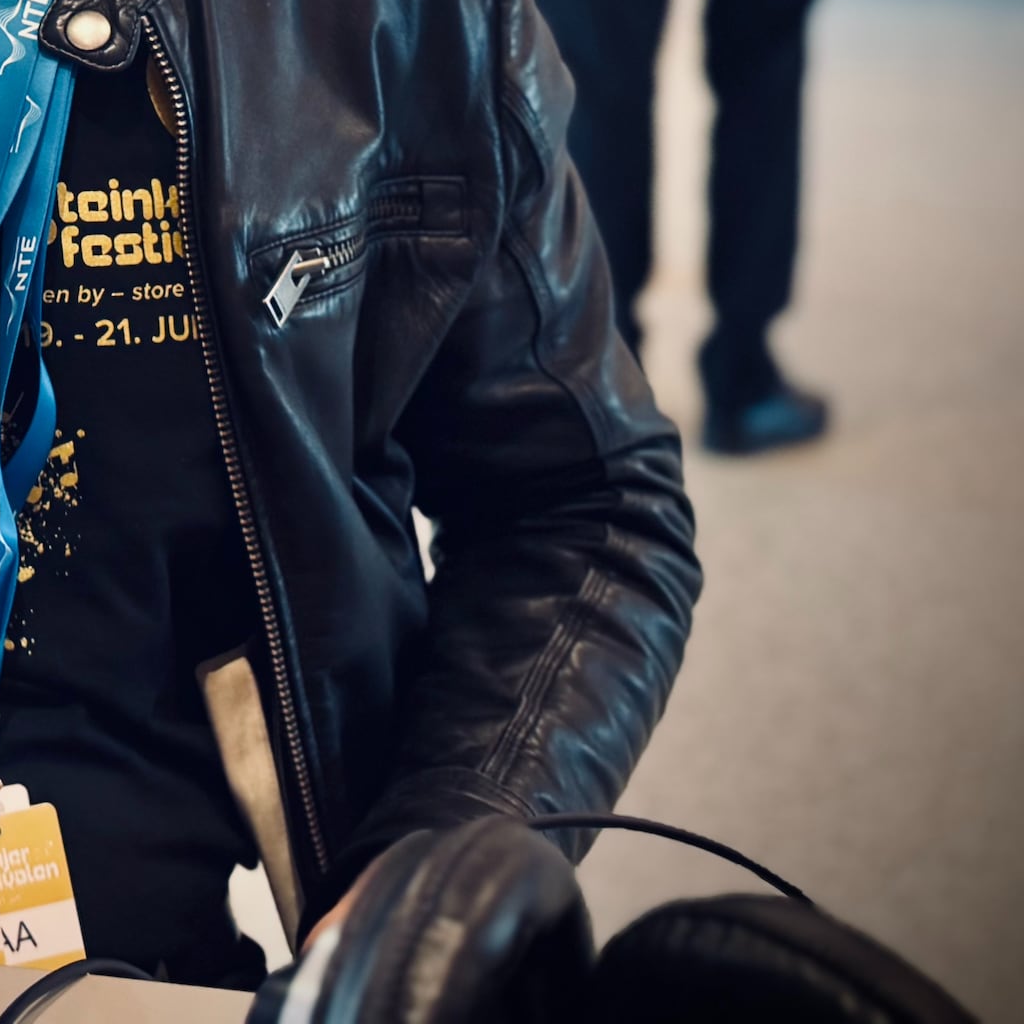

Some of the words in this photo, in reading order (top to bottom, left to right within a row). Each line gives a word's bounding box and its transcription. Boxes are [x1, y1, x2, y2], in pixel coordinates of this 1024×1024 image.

[14, 236, 37, 292] NTE
[42, 288, 70, 304] en
[77, 284, 105, 308] by
[132, 282, 185, 301] store
[95, 318, 142, 347] 21.
